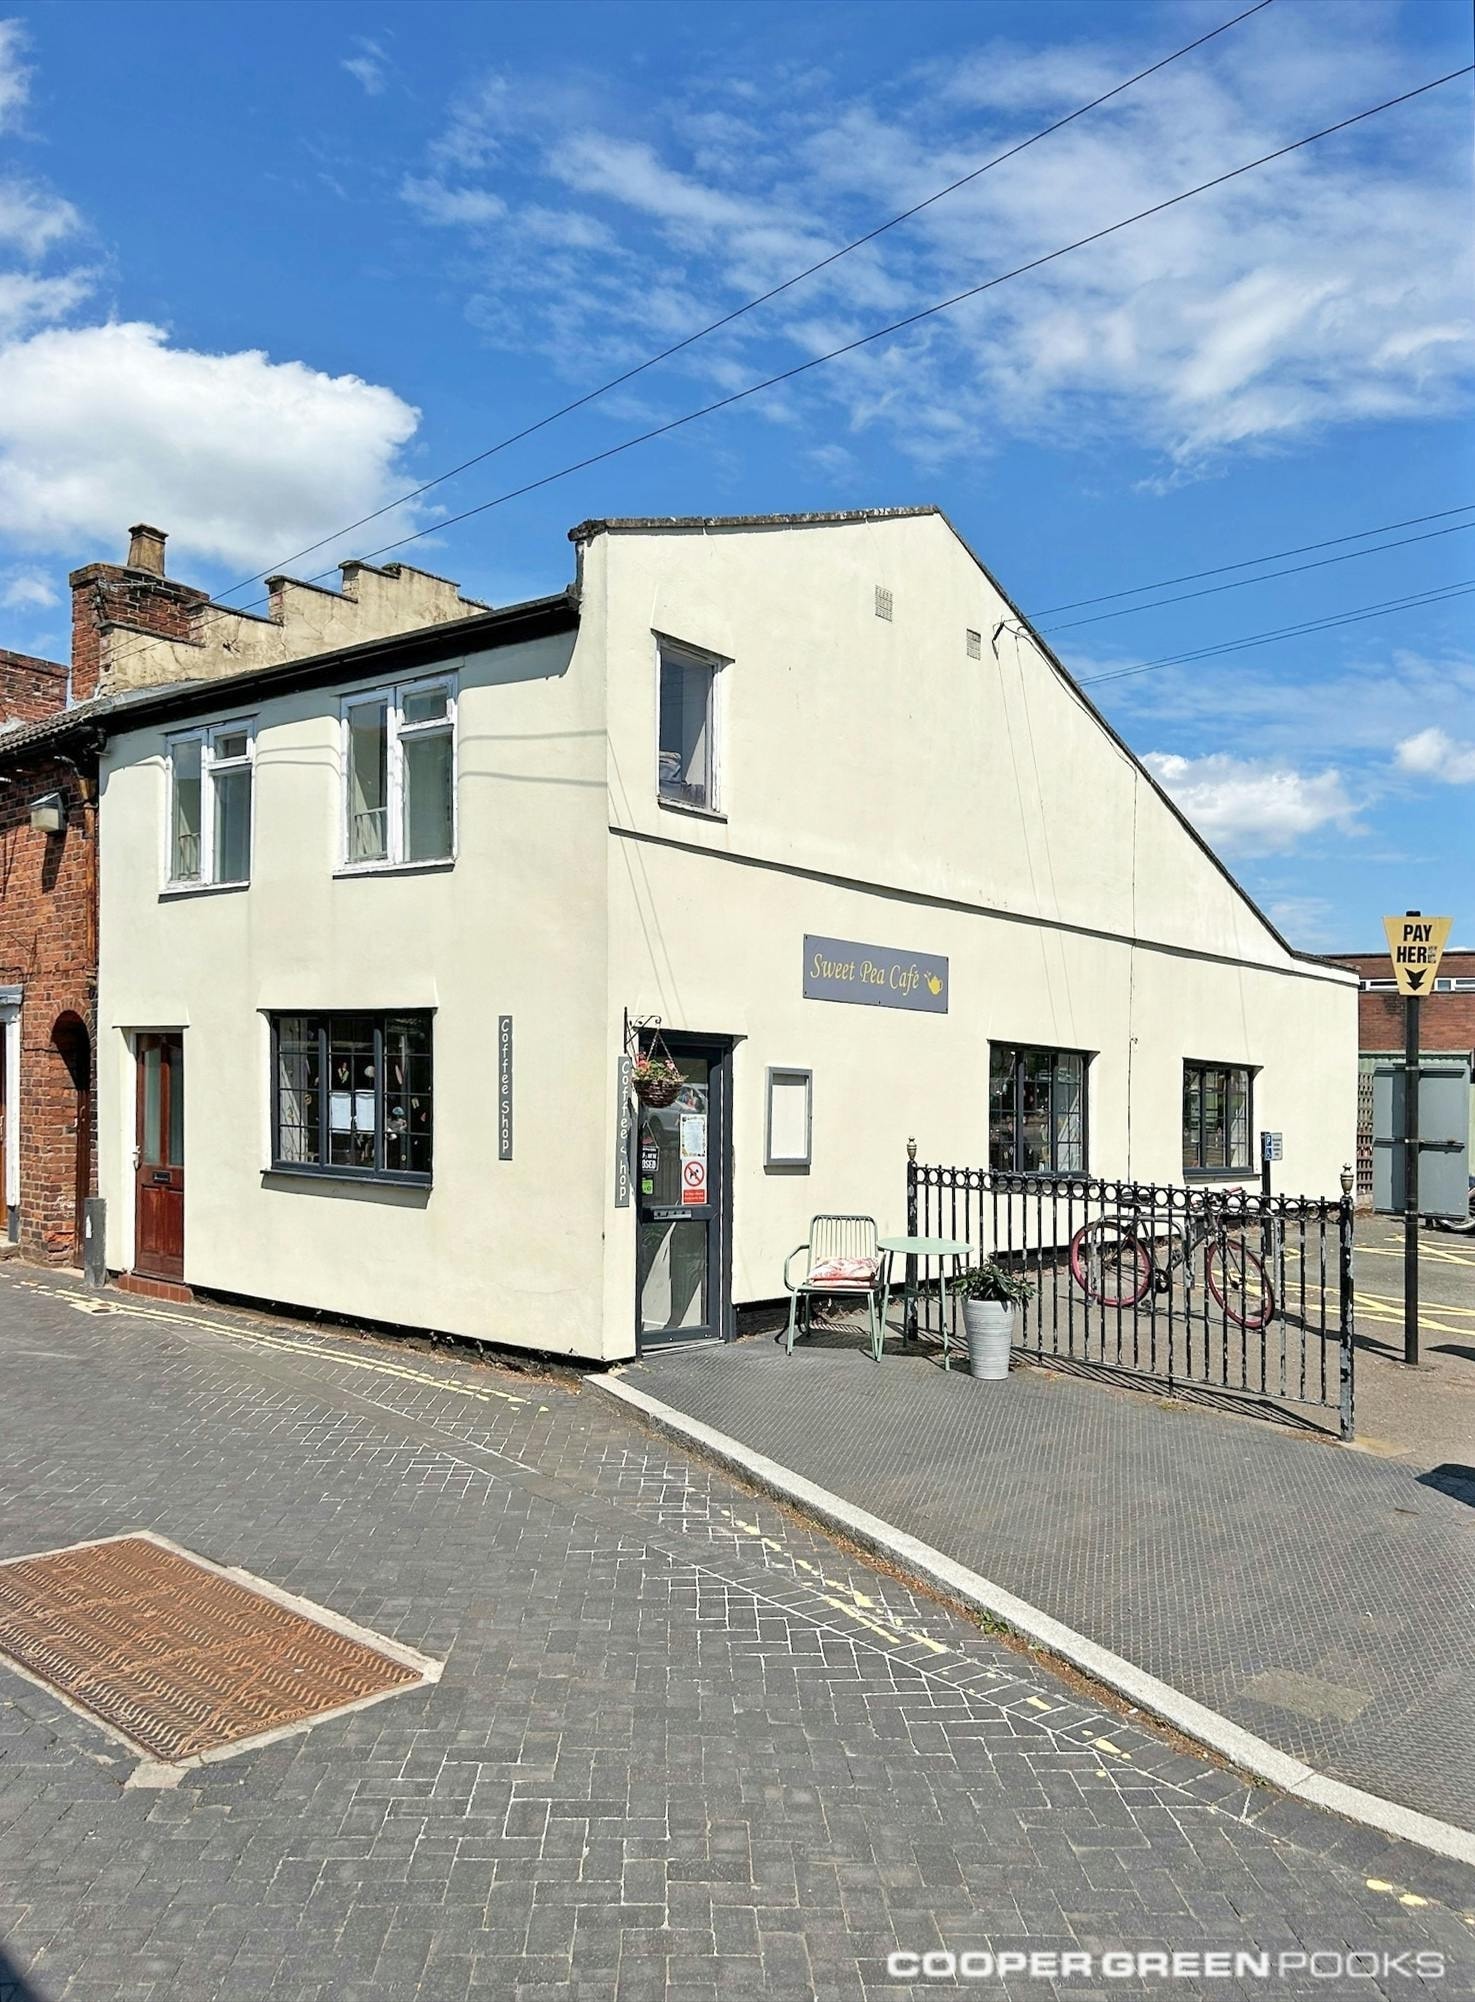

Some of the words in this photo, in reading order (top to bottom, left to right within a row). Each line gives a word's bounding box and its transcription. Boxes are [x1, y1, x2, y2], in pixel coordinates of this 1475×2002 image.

[1402, 924, 1432, 942] PAY
[810, 953, 856, 981] Sweet
[860, 960, 885, 985] Pea
[889, 964, 920, 996] Café
[501, 1019, 510, 1095] Coffee
[620, 1060, 630, 1139] Coffee
[501, 1100, 510, 1153] Shop
